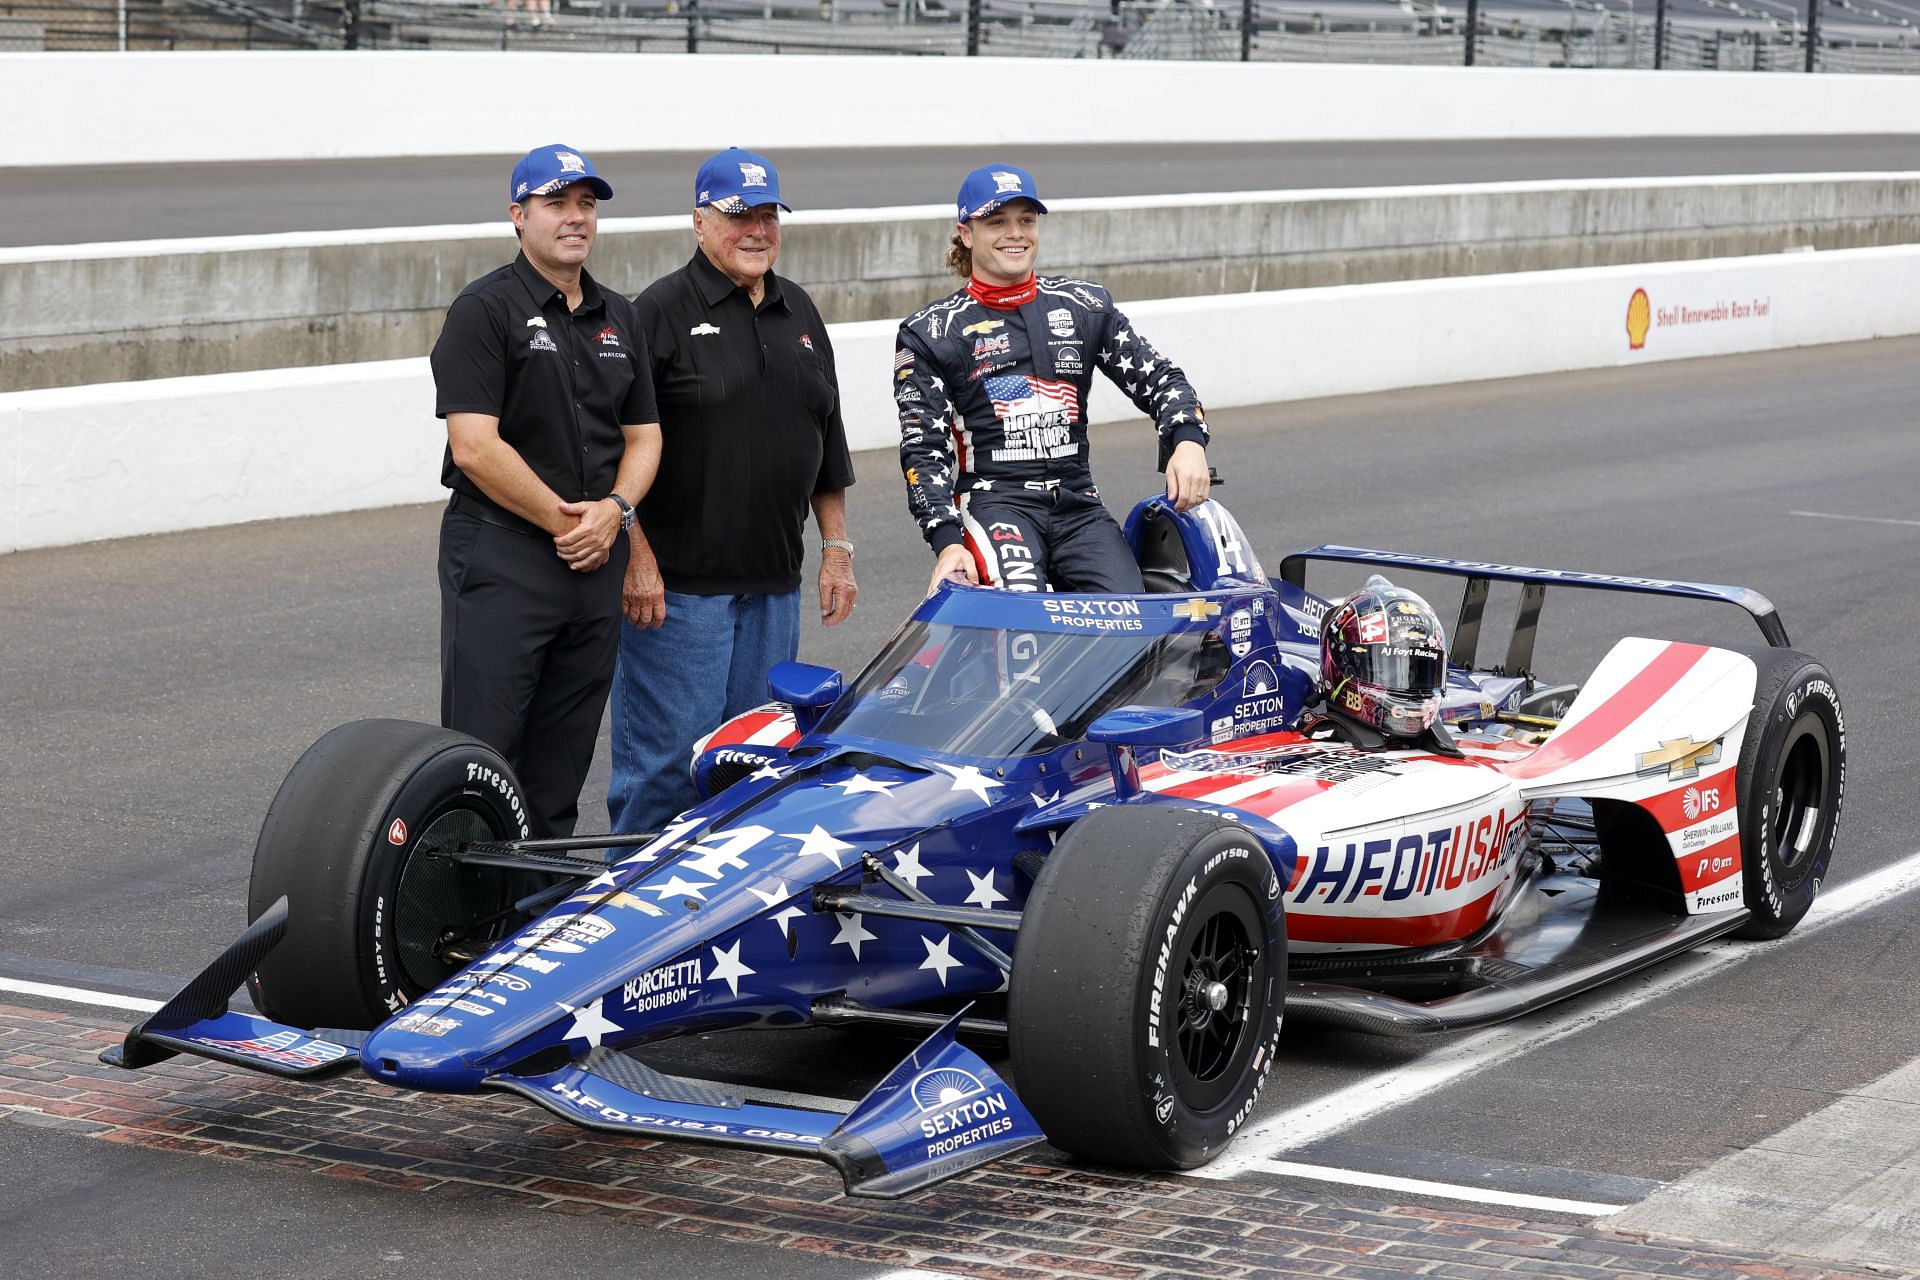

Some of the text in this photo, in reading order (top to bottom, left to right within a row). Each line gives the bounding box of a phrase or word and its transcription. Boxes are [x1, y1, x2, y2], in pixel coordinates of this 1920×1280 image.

[1657, 296, 1771, 327] Shell Renewable Race Fuel
[971, 332, 1010, 356] ABC
[1054, 361, 1083, 369] SEXTON
[1003, 408, 1071, 433] HOMES
[1004, 430, 1025, 441] for
[1004, 439, 1026, 449] our
[1023, 424, 1071, 449] TROOPS
[1196, 498, 1247, 577] 14
[1043, 599, 1140, 616] SEXTON
[1050, 615, 1143, 631] PROPERTIES
[1360, 613, 1385, 642] 14
[1381, 647, 1438, 659] AJ Foyt Racing
[1234, 696, 1284, 719] SEXTON
[1806, 679, 1847, 753] FIREHAWK
[1234, 715, 1284, 735] PROPERTIES
[466, 762, 530, 841] Firestone
[1701, 788, 1720, 812] IFS
[613, 817, 775, 881] 14
[1761, 804, 1783, 918] Firestone
[1696, 890, 1740, 910] Firestone
[1148, 875, 1198, 1048] FIREHAWK
[623, 958, 702, 1005] BORCHETTA
[638, 987, 688, 1013] BOURBON
[1227, 1013, 1284, 1137] Firestone
[920, 1092, 1008, 1139] SEXTON
[927, 1117, 1013, 1159] PROPERTIES
